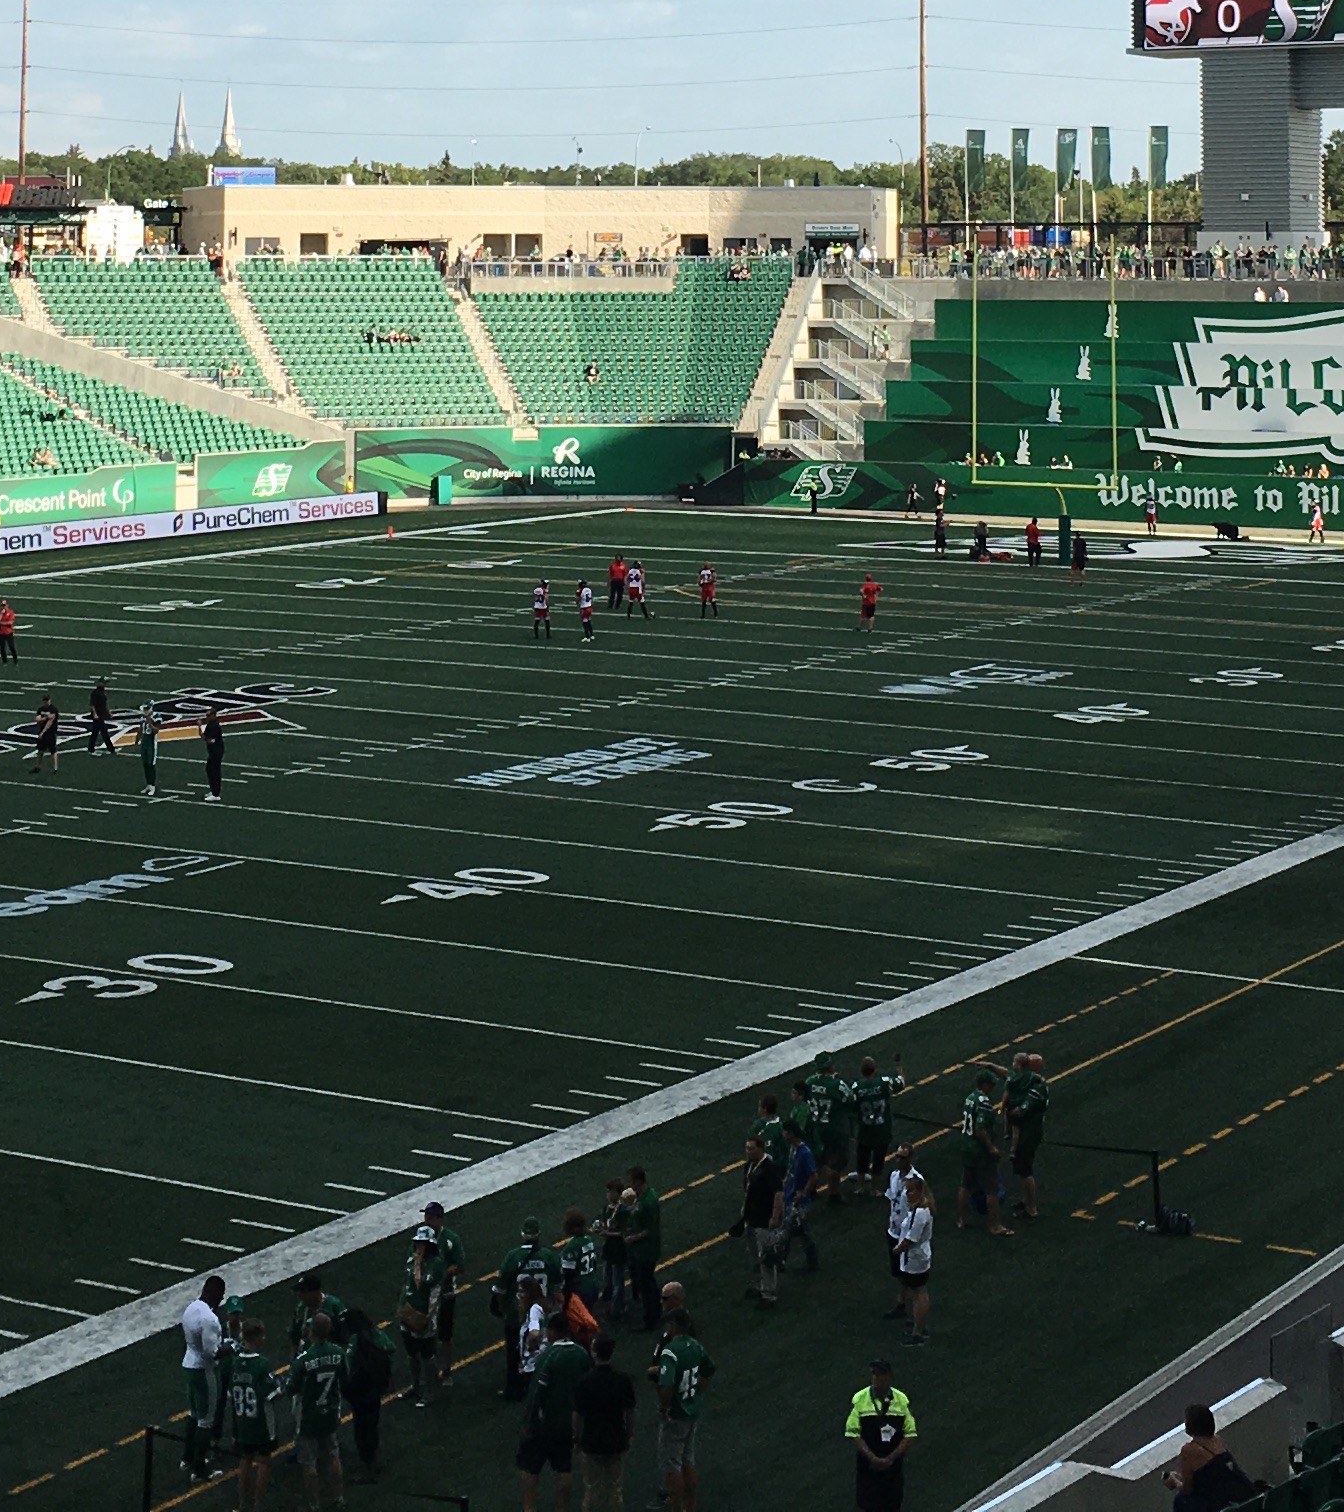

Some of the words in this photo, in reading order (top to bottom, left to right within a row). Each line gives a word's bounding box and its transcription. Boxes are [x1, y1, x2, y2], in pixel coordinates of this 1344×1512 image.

[1217, 0, 1241, 33] 0
[143, 198, 168, 209] Gate
[170, 199, 178, 208] 4
[1196, 350, 1318, 416] Pil
[463, 468, 481, 481] City
[482, 468, 492, 479] of
[492, 468, 523, 481] Regina
[541, 466, 596, 478] REGINA
[68, 489, 107, 510] Point
[298, 497, 374, 520] Services
[1254, 483, 1284, 513] to
[53, 520, 146, 546] Services
[1053, 704, 1150, 725] 40
[454, 737, 680, 787] HUMBOLDT
[547, 748, 713, 787] STRONG
[870, 746, 990, 773] 50
[669, 801, 794, 830] 50
[408, 866, 551, 901] 40
[42, 953, 234, 1000] 30
[232, 1385, 257, 1418] 89
[316, 1371, 336, 1406] 7
